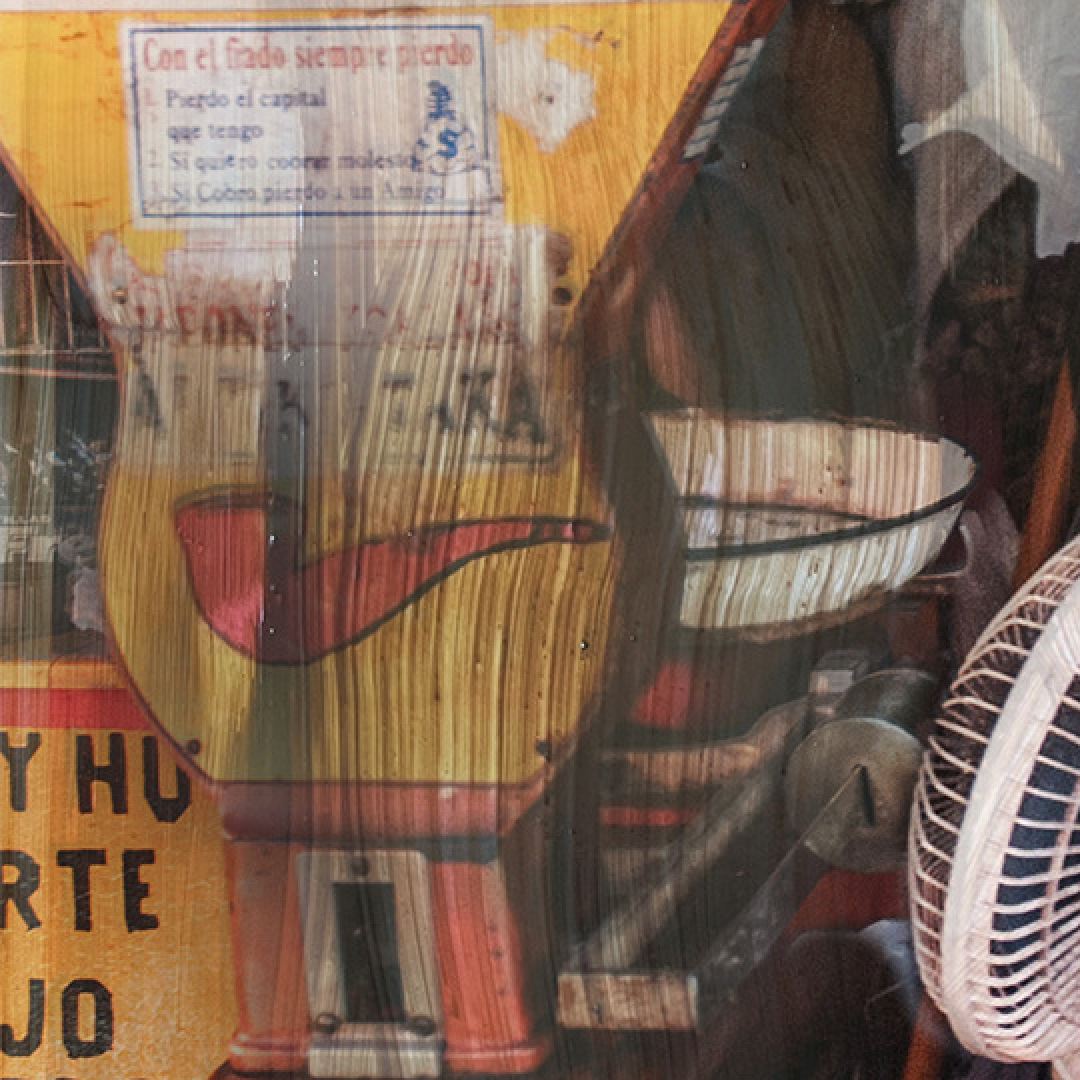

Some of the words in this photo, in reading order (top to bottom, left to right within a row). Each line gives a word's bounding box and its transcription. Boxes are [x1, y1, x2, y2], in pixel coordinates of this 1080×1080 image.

[143, 37, 188, 71] Con
[195, 37, 217, 73] el
[166, 88, 230, 112] Pierdo
[235, 87, 255, 108] el
[259, 86, 327, 113] capital
[167, 125, 201, 145] que
[207, 123, 264, 143] tengo
